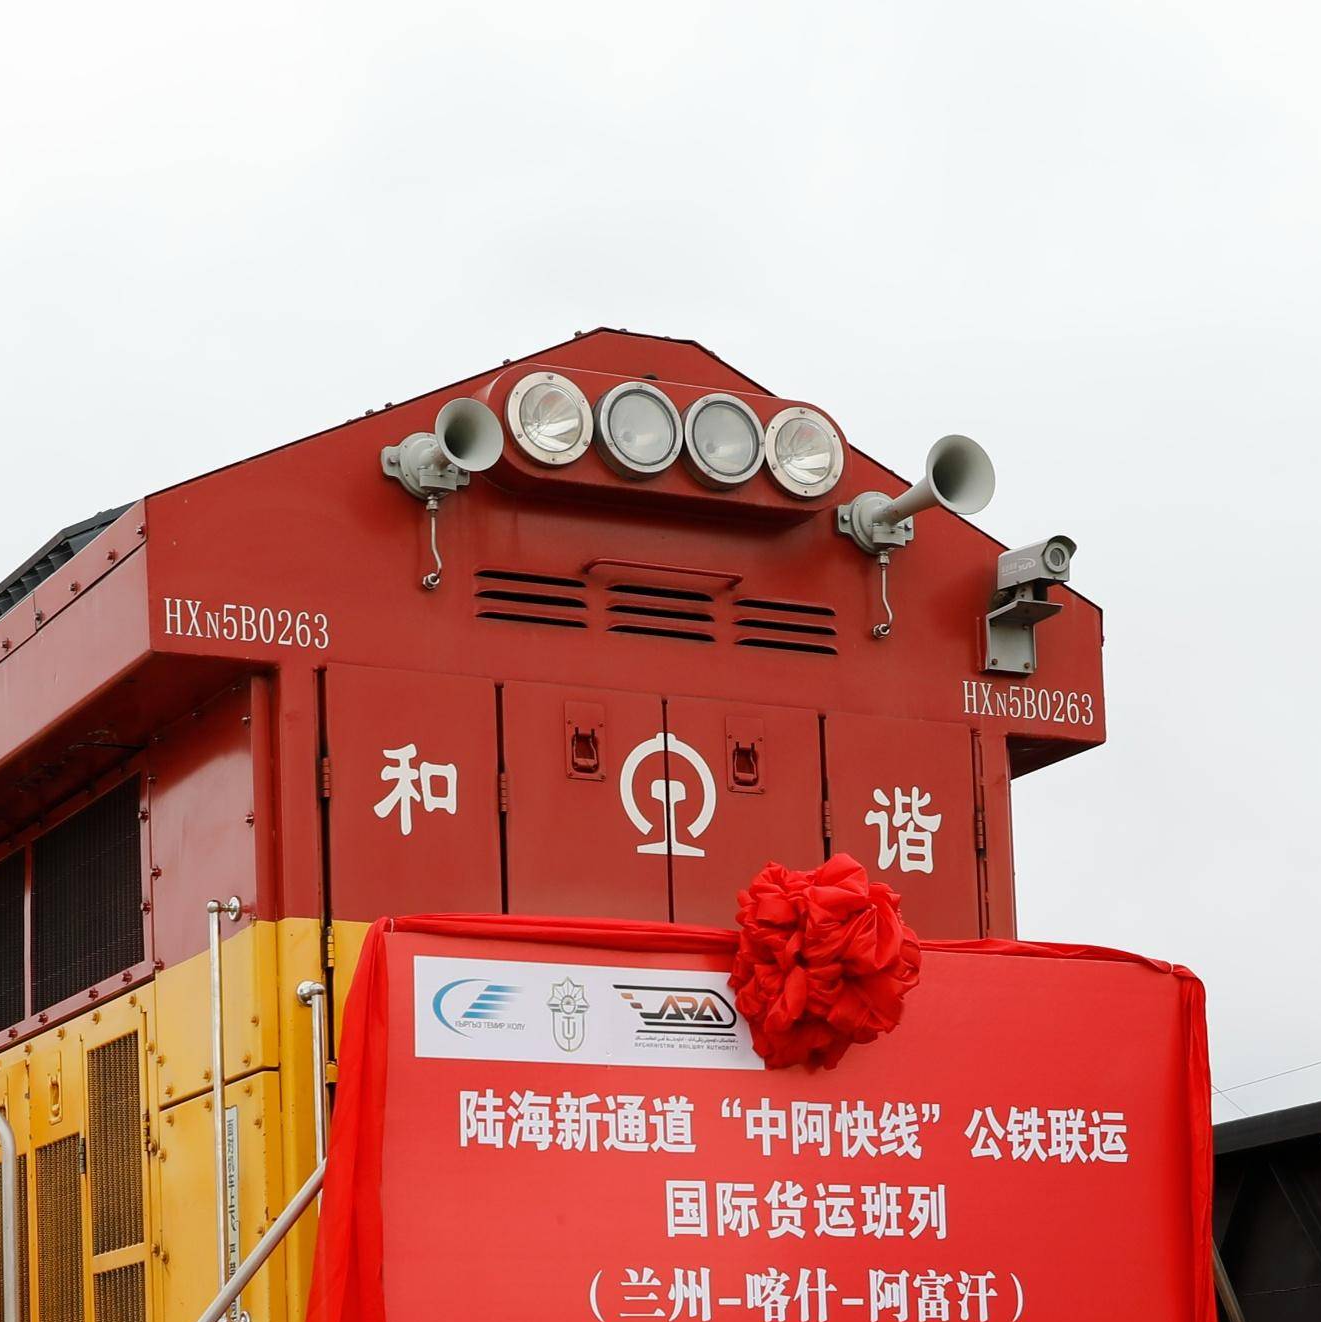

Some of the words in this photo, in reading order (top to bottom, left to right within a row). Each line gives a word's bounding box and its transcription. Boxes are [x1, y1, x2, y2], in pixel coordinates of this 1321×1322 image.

[374, 743, 457, 836] 和
[864, 786, 942, 874] 谐
[639, 995, 724, 1022] ARA
[459, 1088, 697, 1153] 陆海新通道
[721, 1097, 941, 1160] “中阿快线”
[964, 1106, 1129, 1164] 公铁联运
[665, 1179, 947, 1240] 国际货运班列
